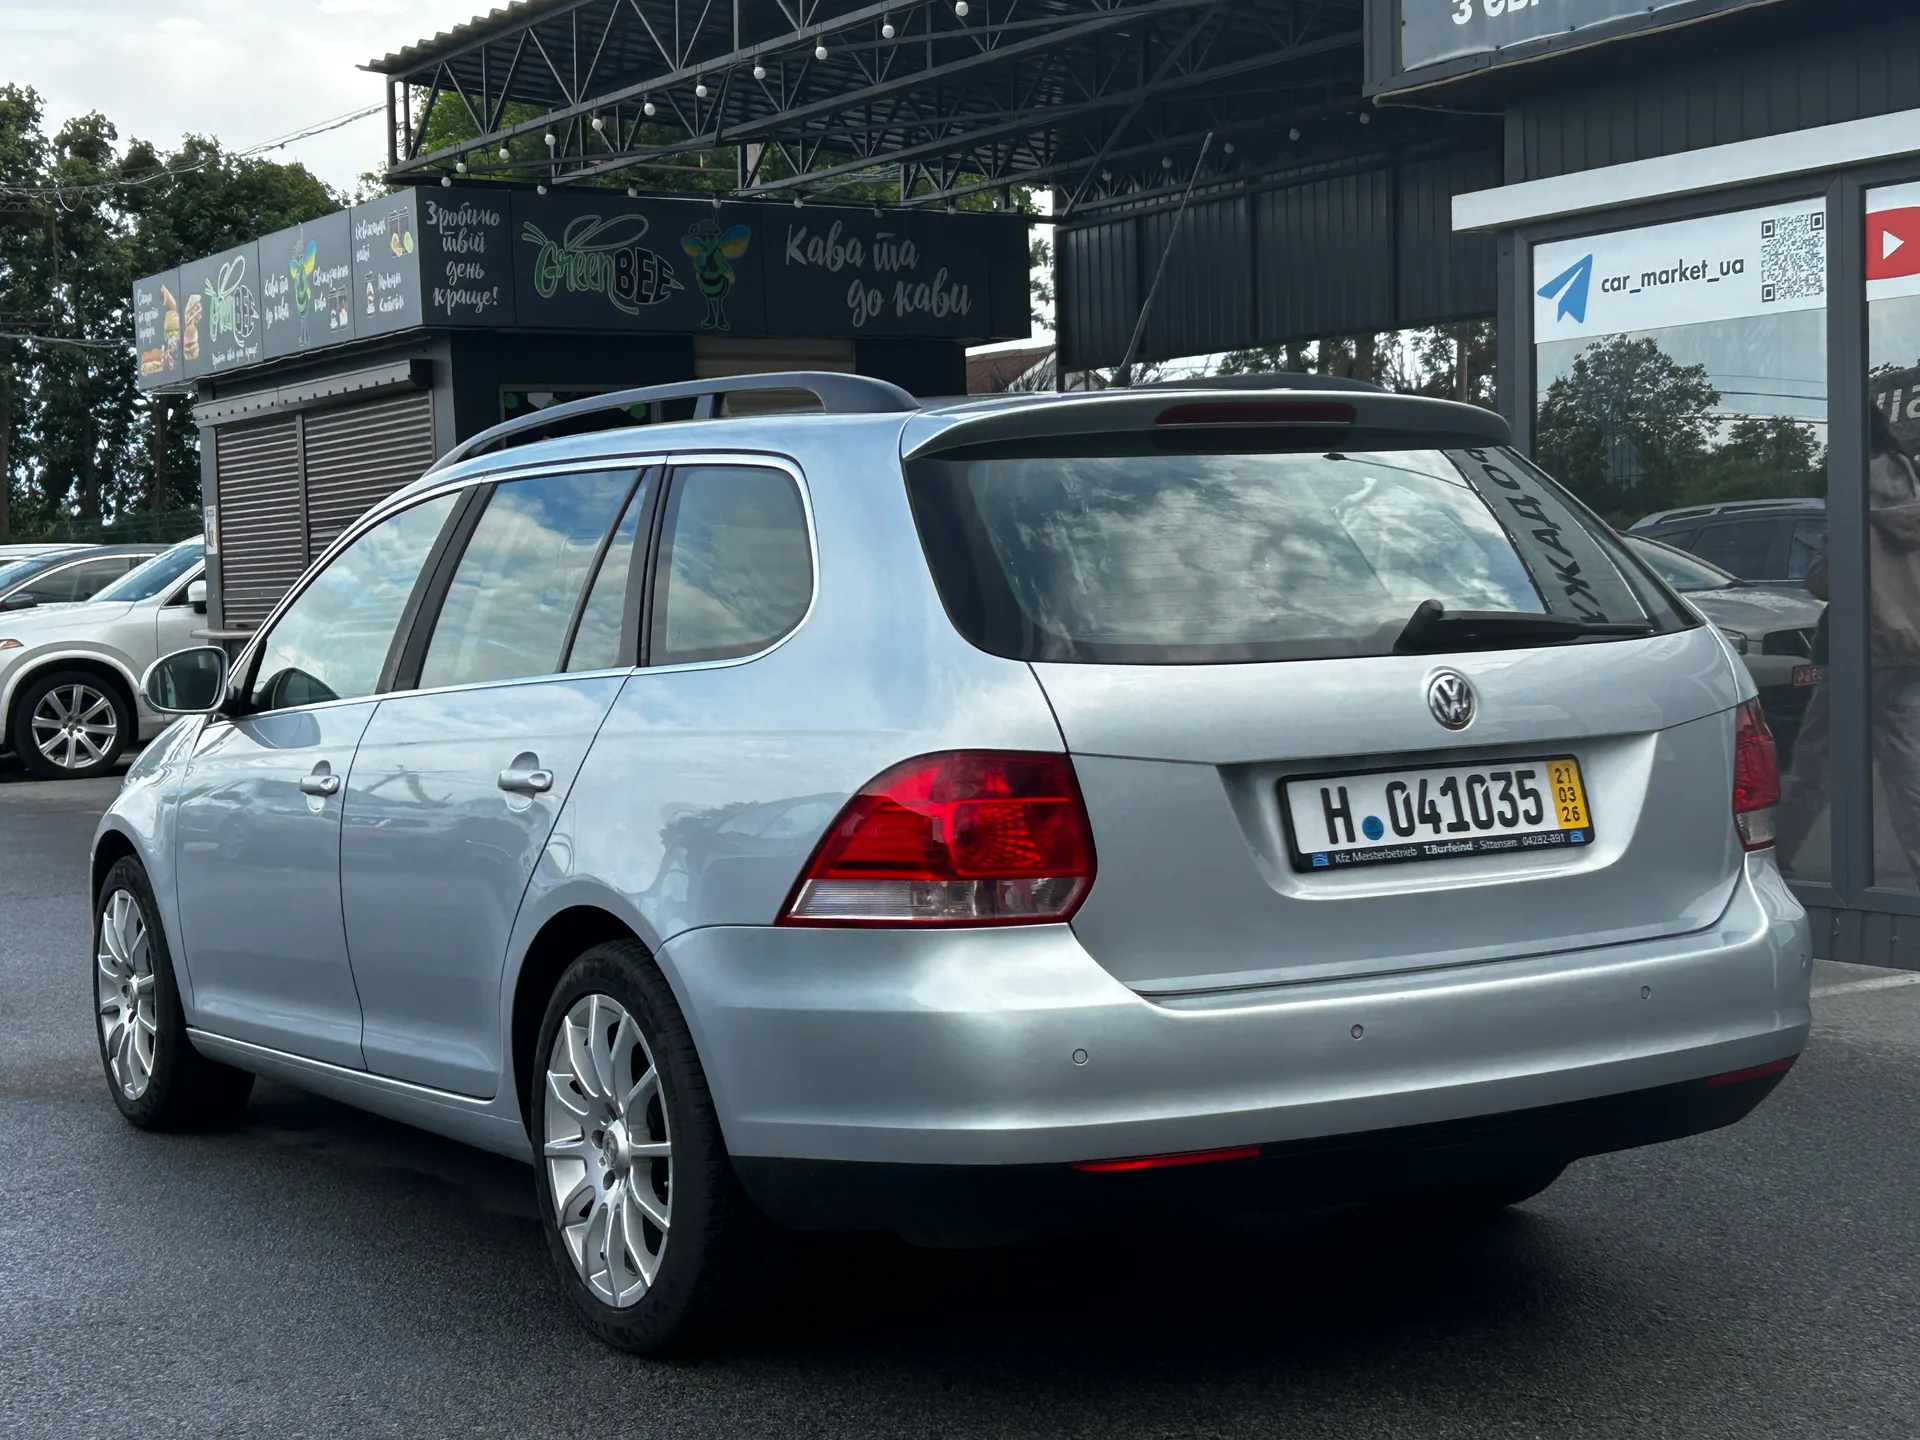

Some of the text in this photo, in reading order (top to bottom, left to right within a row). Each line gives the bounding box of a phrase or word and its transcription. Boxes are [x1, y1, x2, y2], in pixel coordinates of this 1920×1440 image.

[426, 200, 500, 234] Зробимо
[442, 227, 487, 253] твій
[785, 220, 920, 272] Кава та
[445, 261, 485, 286] день
[1601, 258, 1744, 294] car_market_ua
[432, 286, 499, 315] краще!
[847, 267, 971, 327] до кави
[1555, 767, 1572, 784] 21
[1321, 770, 1543, 844] H 041035
[1558, 786, 1577, 803] 03
[1562, 805, 1580, 822] 26
